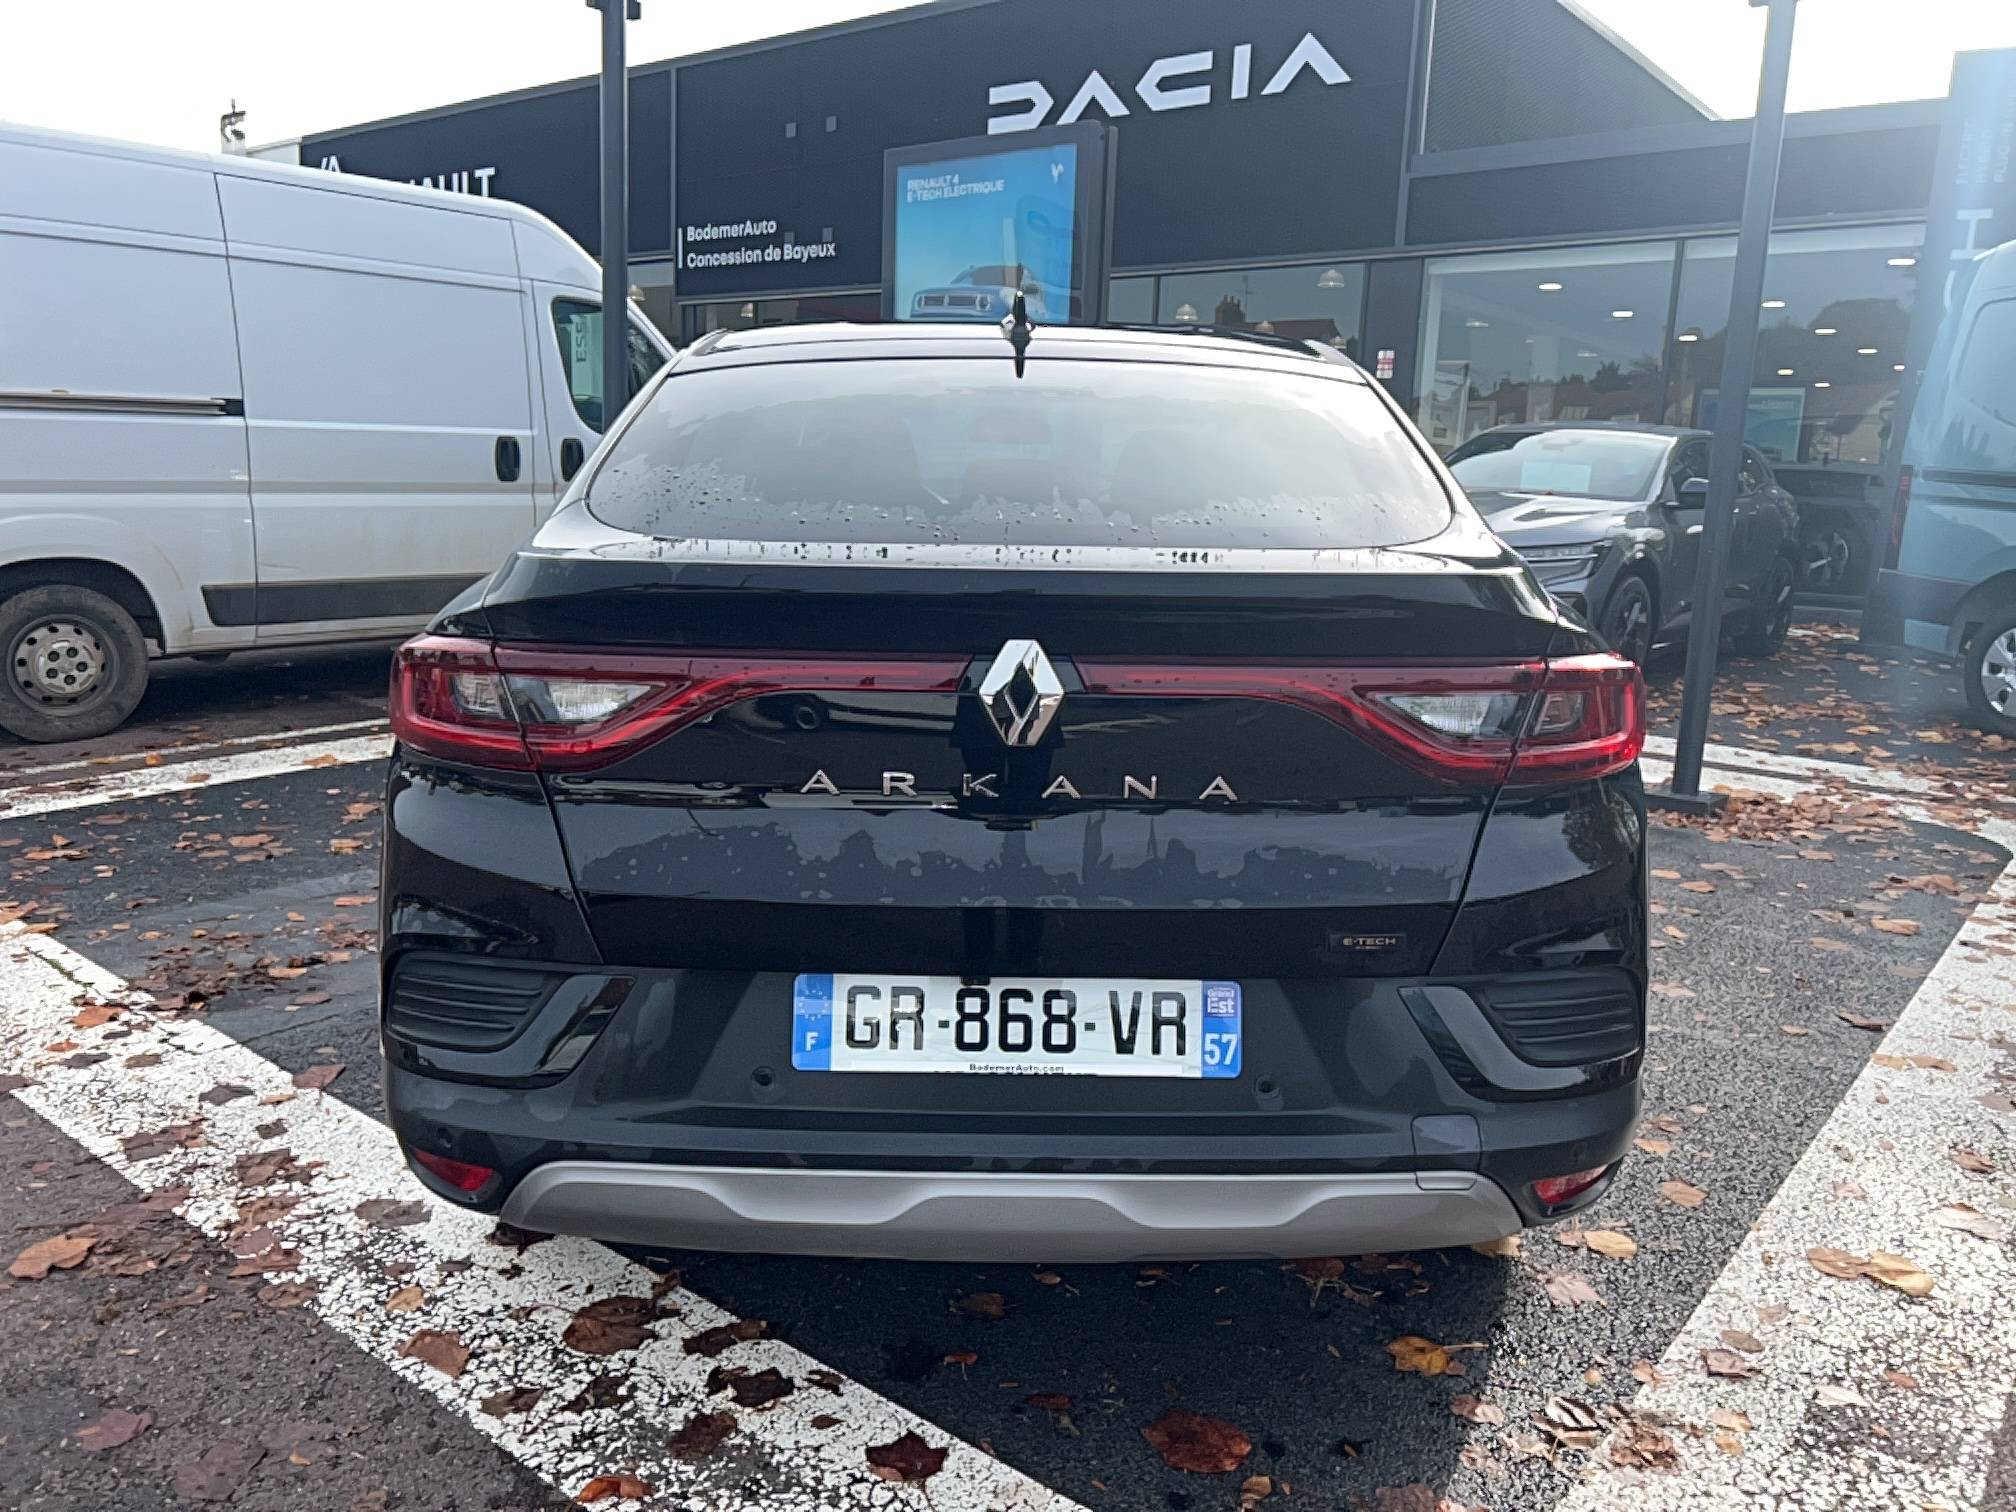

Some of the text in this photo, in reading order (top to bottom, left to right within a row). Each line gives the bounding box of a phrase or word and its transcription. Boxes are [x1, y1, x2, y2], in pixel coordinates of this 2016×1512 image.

[987, 32, 1351, 135] DACIA
[907, 173, 960, 190] RENAULT 4
[907, 188, 943, 203] E-TECH
[686, 220, 777, 242] BodemerAuto
[686, 242, 836, 268] Concession de Bayeux
[575, 315, 588, 363] ESS
[800, 769, 1238, 801] ARKANA
[1343, 937, 1396, 946] E-TECH
[1206, 997, 1235, 1014] Est
[846, 984, 1187, 1056] GR-868-VR
[805, 1031, 819, 1052] F
[1203, 1032, 1238, 1066] 57
[969, 1063, 1065, 1073] BodemerAuto.com
